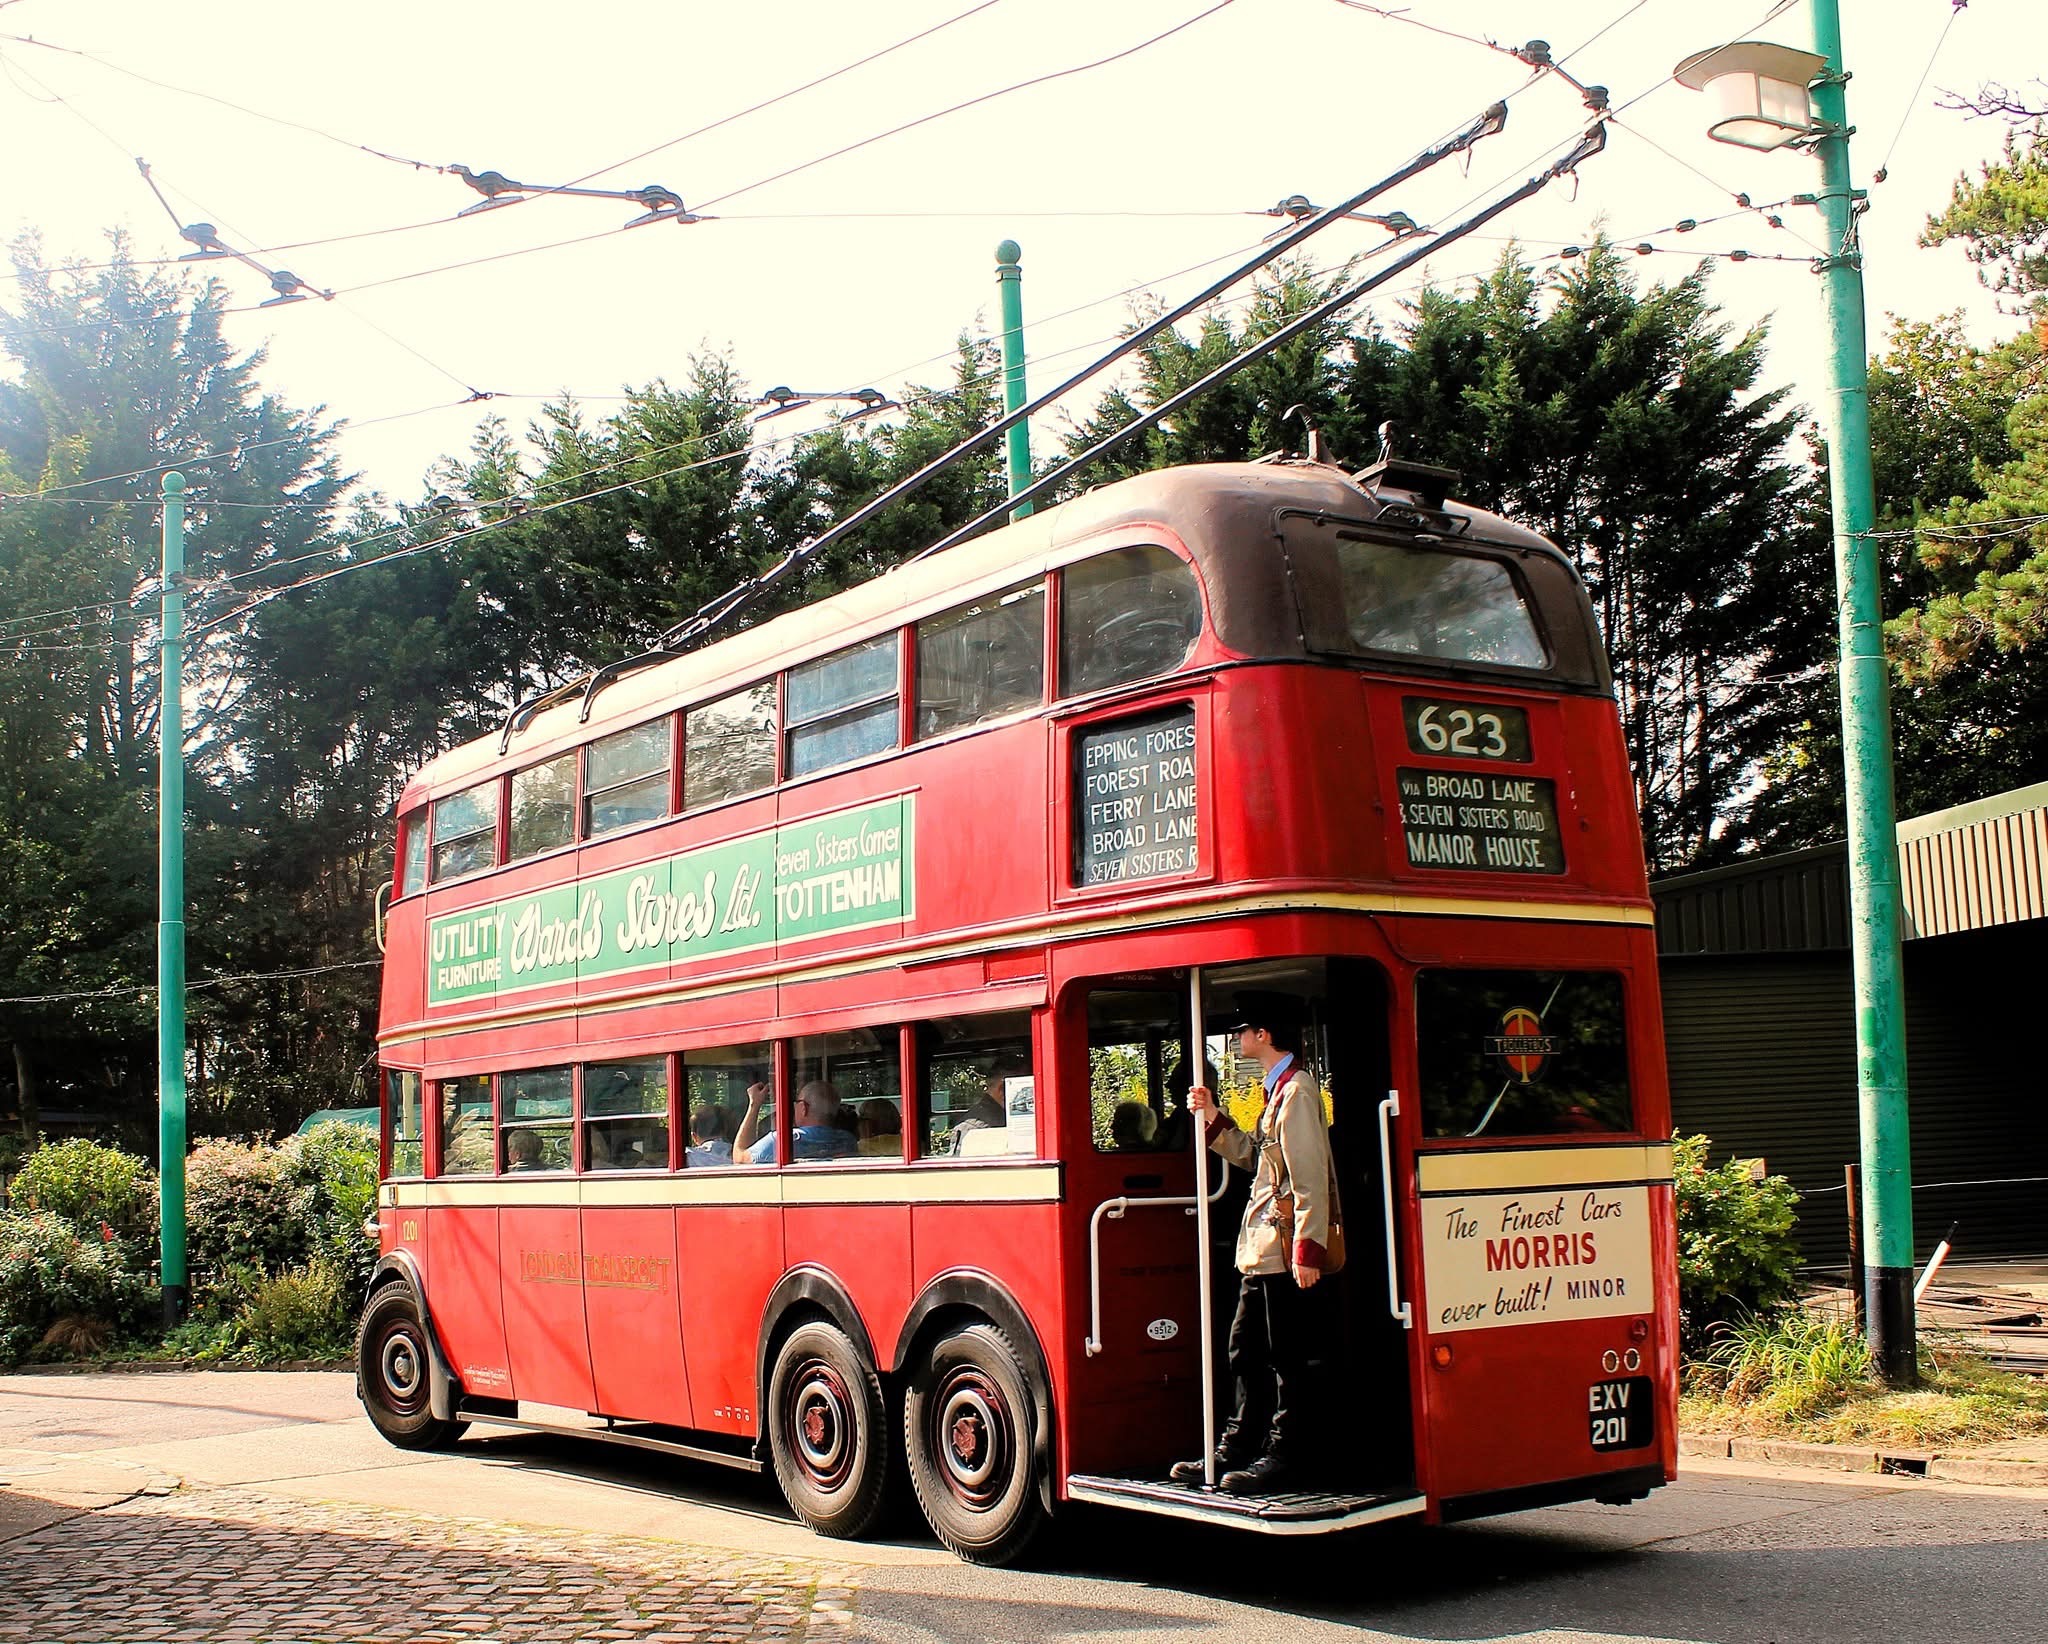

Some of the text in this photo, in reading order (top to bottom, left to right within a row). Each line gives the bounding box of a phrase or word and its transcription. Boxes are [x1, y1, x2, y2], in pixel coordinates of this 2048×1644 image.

[1418, 706, 1506, 757] 623
[1086, 737, 1138, 768] EPPING
[1087, 765, 1149, 797] FOREST
[1427, 776, 1484, 800] BROAD
[1492, 780, 1535, 803] LANE
[1091, 784, 1197, 825] FERRY LANE
[1409, 804, 1454, 826] SEVEN
[1459, 806, 1509, 830] SISTERS
[1514, 810, 1545, 832] ROAD
[815, 831, 859, 869] Sisters
[860, 819, 900, 857] Corner
[1093, 815, 1197, 854] BROAD LANE
[1407, 832, 1545, 868] MANOR HOUSE
[1089, 858, 1128, 883] SEVEN
[1131, 848, 1184, 877] SISTERS
[773, 858, 900, 924] TOTTENHAM
[510, 863, 762, 974] Ward's Stores Ltd.
[433, 912, 506, 963] UTILITY
[438, 957, 502, 990] FURNITURE
[402, 1220, 418, 1241] 1201
[1446, 1192, 1622, 1240] The Finest Cars
[1486, 1232, 1597, 1272] MORRIS
[1441, 1276, 1552, 1325] ever built!
[1567, 1277, 1625, 1300] MINOR
[1589, 1383, 1630, 1412] EXV
[1591, 1417, 1627, 1445] 201
